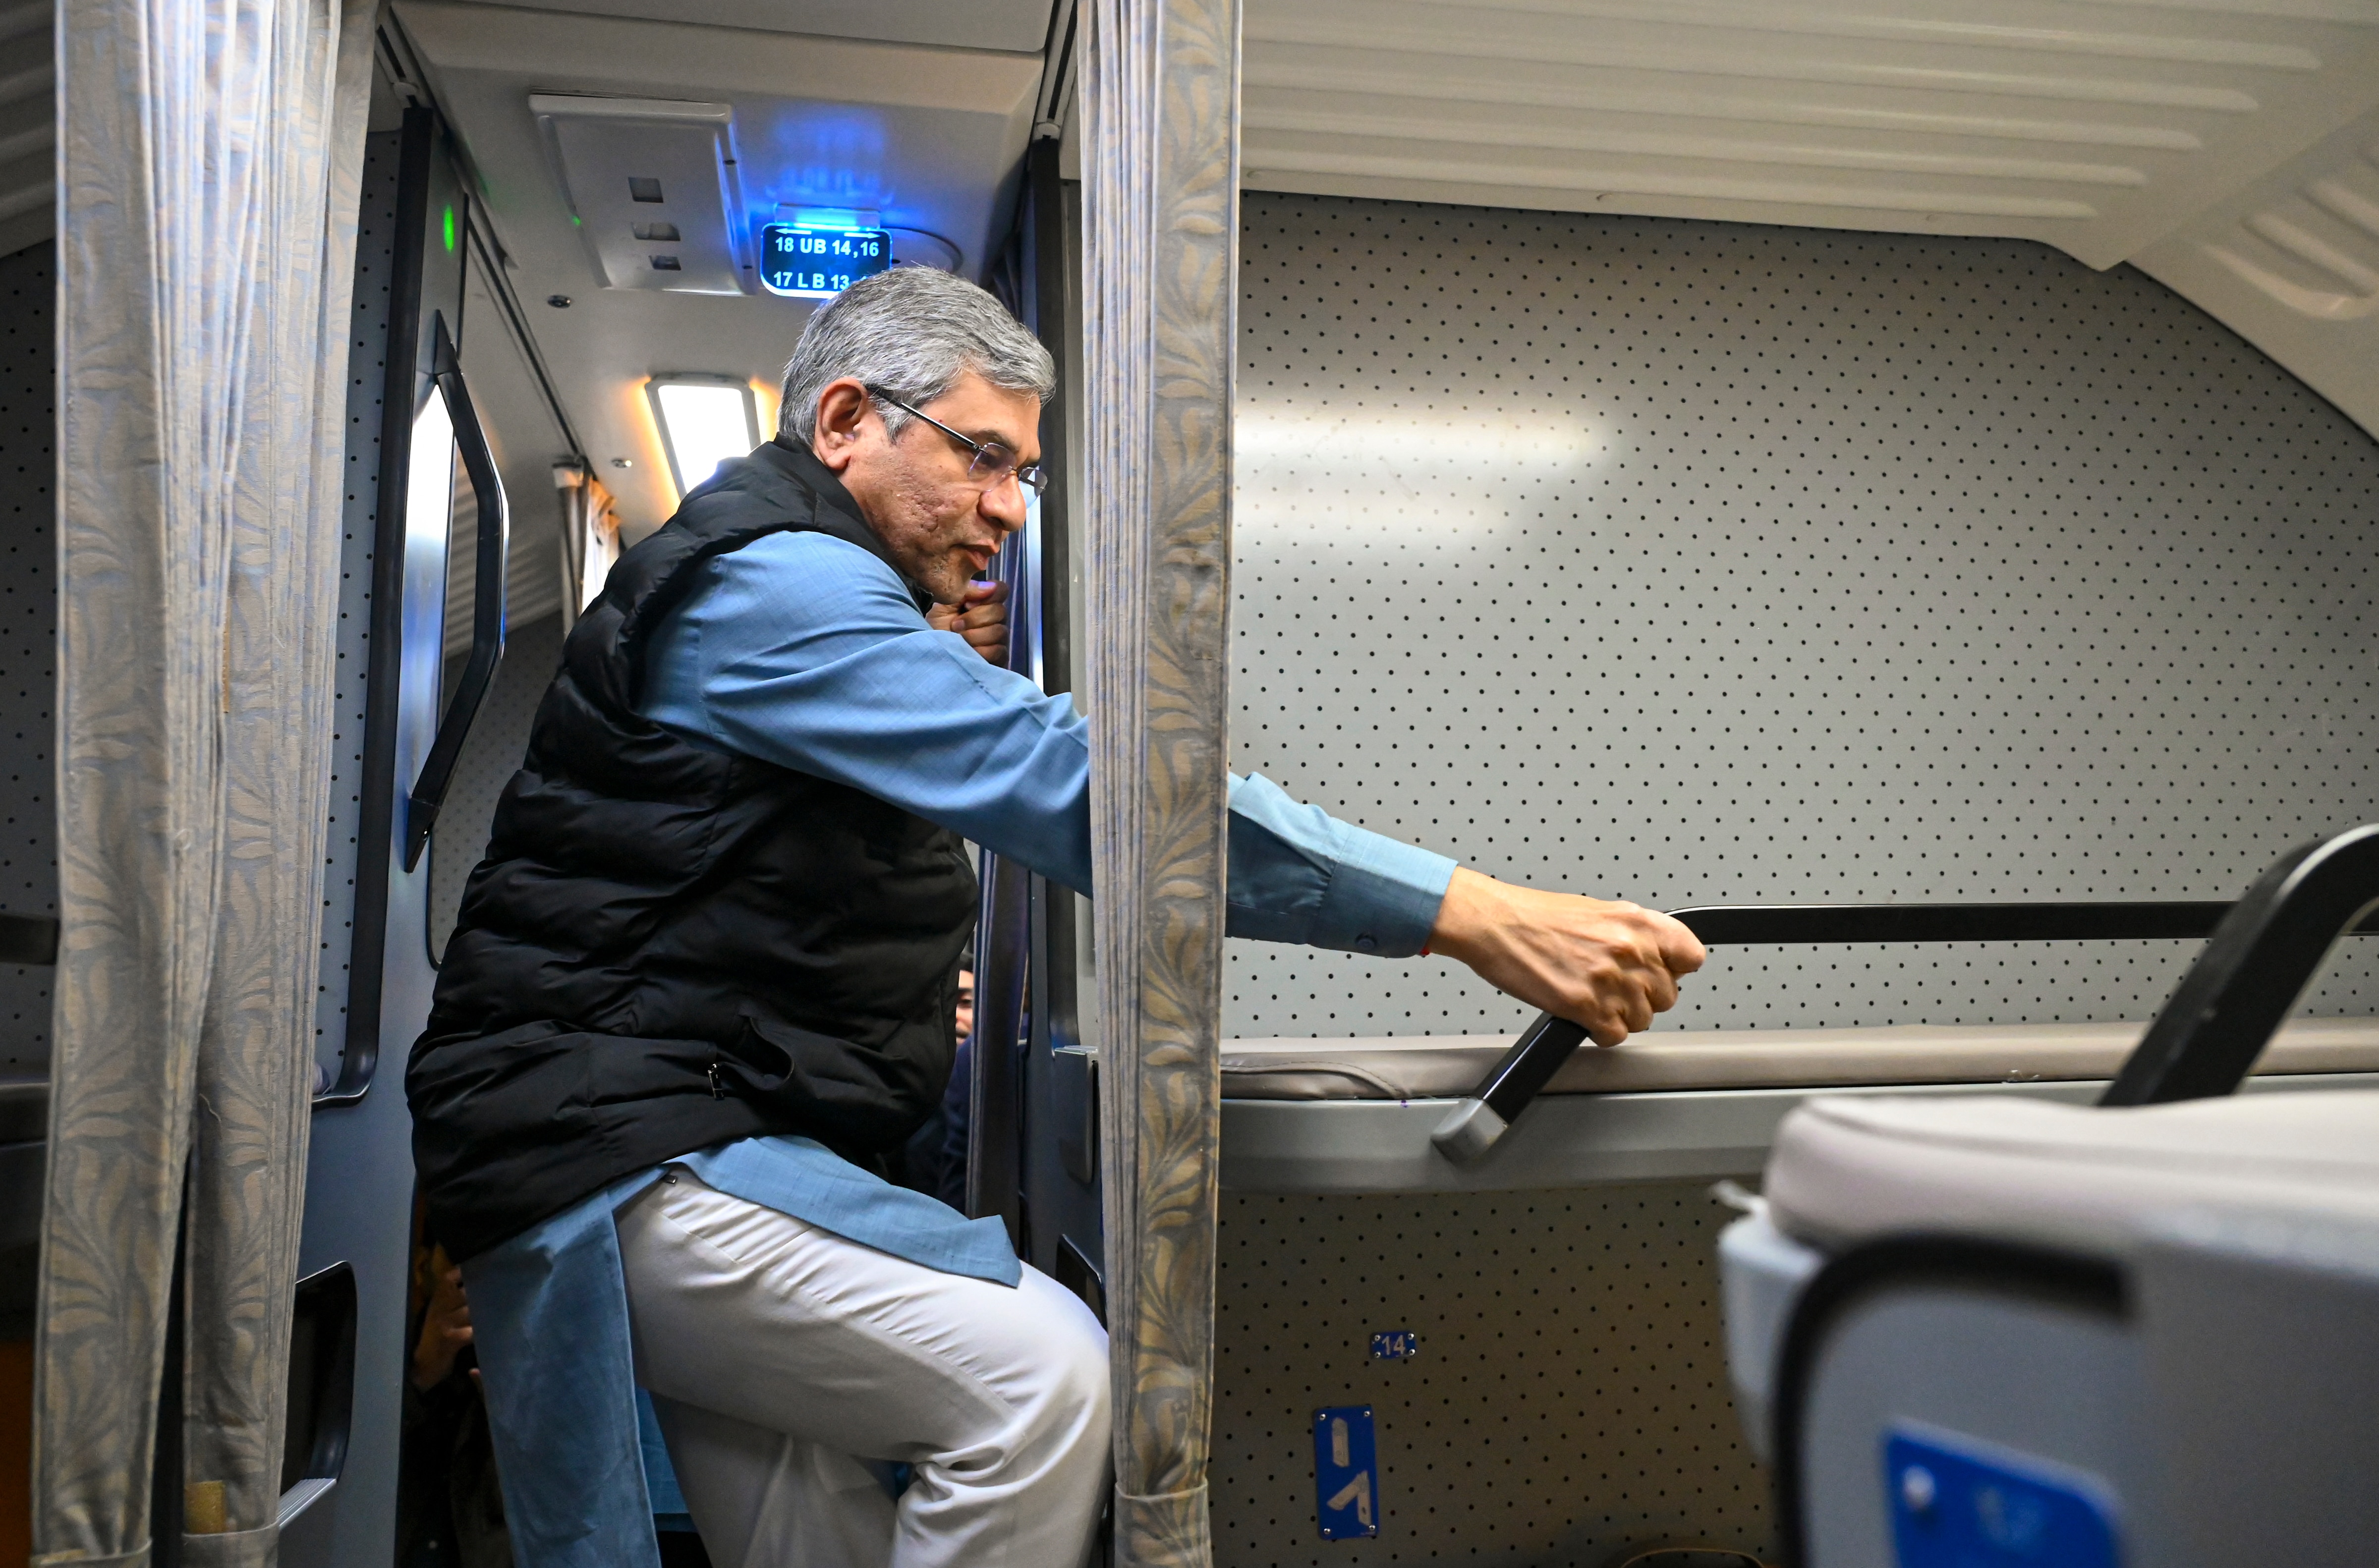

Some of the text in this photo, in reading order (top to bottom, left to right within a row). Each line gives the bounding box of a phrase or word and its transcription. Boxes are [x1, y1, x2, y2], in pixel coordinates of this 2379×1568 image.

[776, 236, 794, 252] 18
[799, 238, 827, 254] UB
[774, 271, 793, 287] 17
[1381, 1335, 1406, 1356] 14
